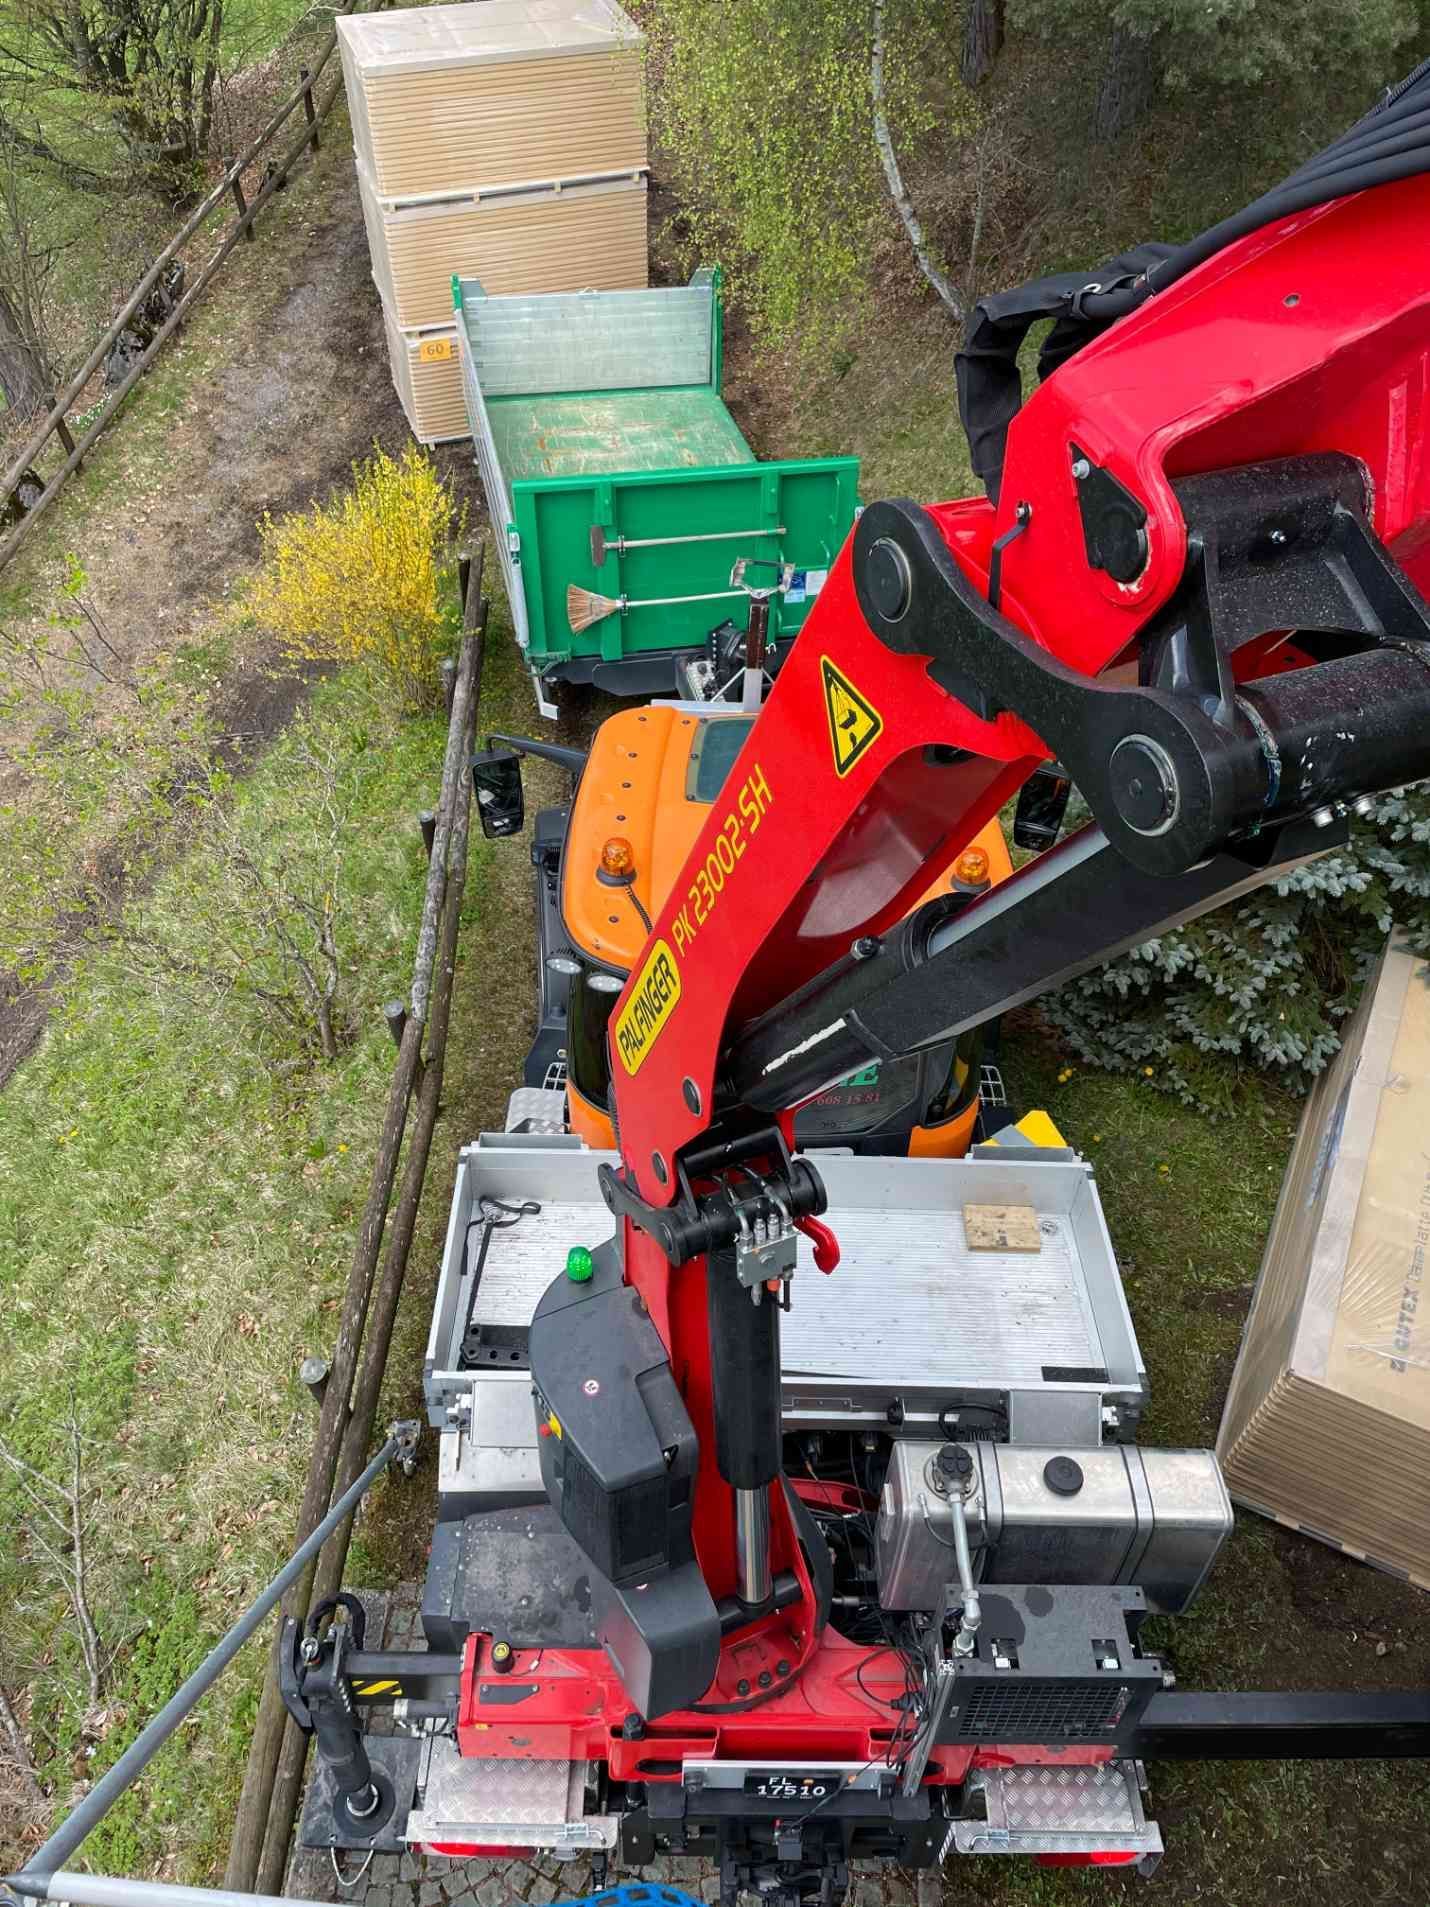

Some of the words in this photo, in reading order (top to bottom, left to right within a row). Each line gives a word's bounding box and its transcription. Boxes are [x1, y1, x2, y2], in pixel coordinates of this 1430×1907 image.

[671, 903, 697, 958] PK
[618, 953, 678, 1068] PALFINGER
[1394, 1285, 1419, 1351] GUTEX
[757, 1785, 826, 1796] 17510
[768, 1777, 792, 1785] FL
